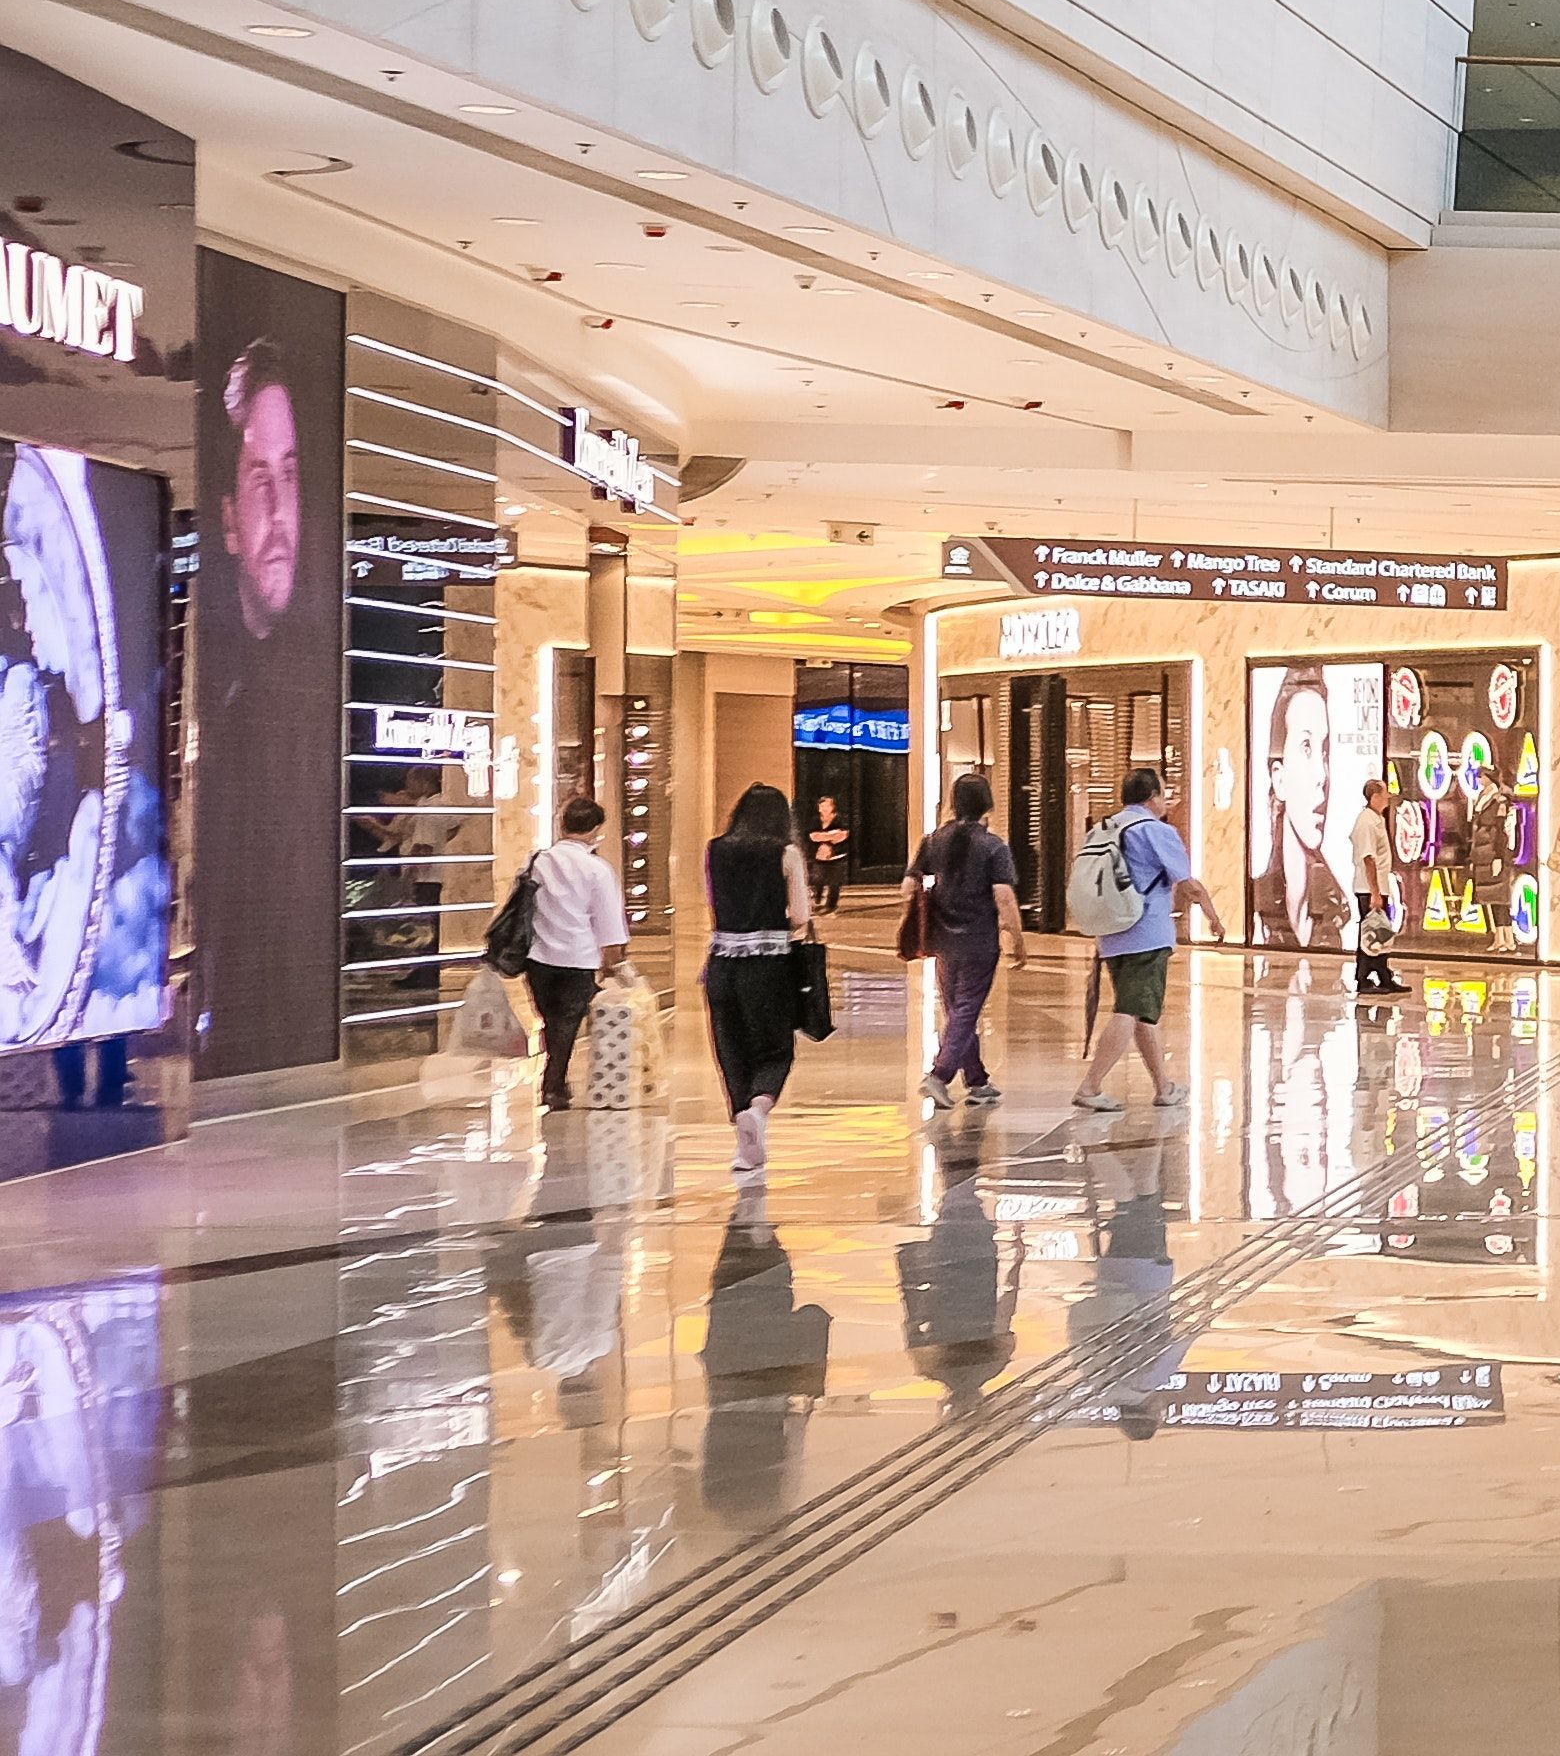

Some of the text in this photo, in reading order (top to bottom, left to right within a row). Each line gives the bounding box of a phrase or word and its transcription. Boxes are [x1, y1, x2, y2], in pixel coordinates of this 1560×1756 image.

[0, 236, 144, 363] UMET
[1052, 546, 1163, 568] Franck Muller
[1187, 550, 1281, 574] Mango Tree
[1305, 556, 1497, 582] Standard Chartered Bank
[1051, 572, 1192, 594] Dolce & Gabbana
[1228, 578, 1286, 598] TASAKI
[1321, 582, 1378, 602] Corum
